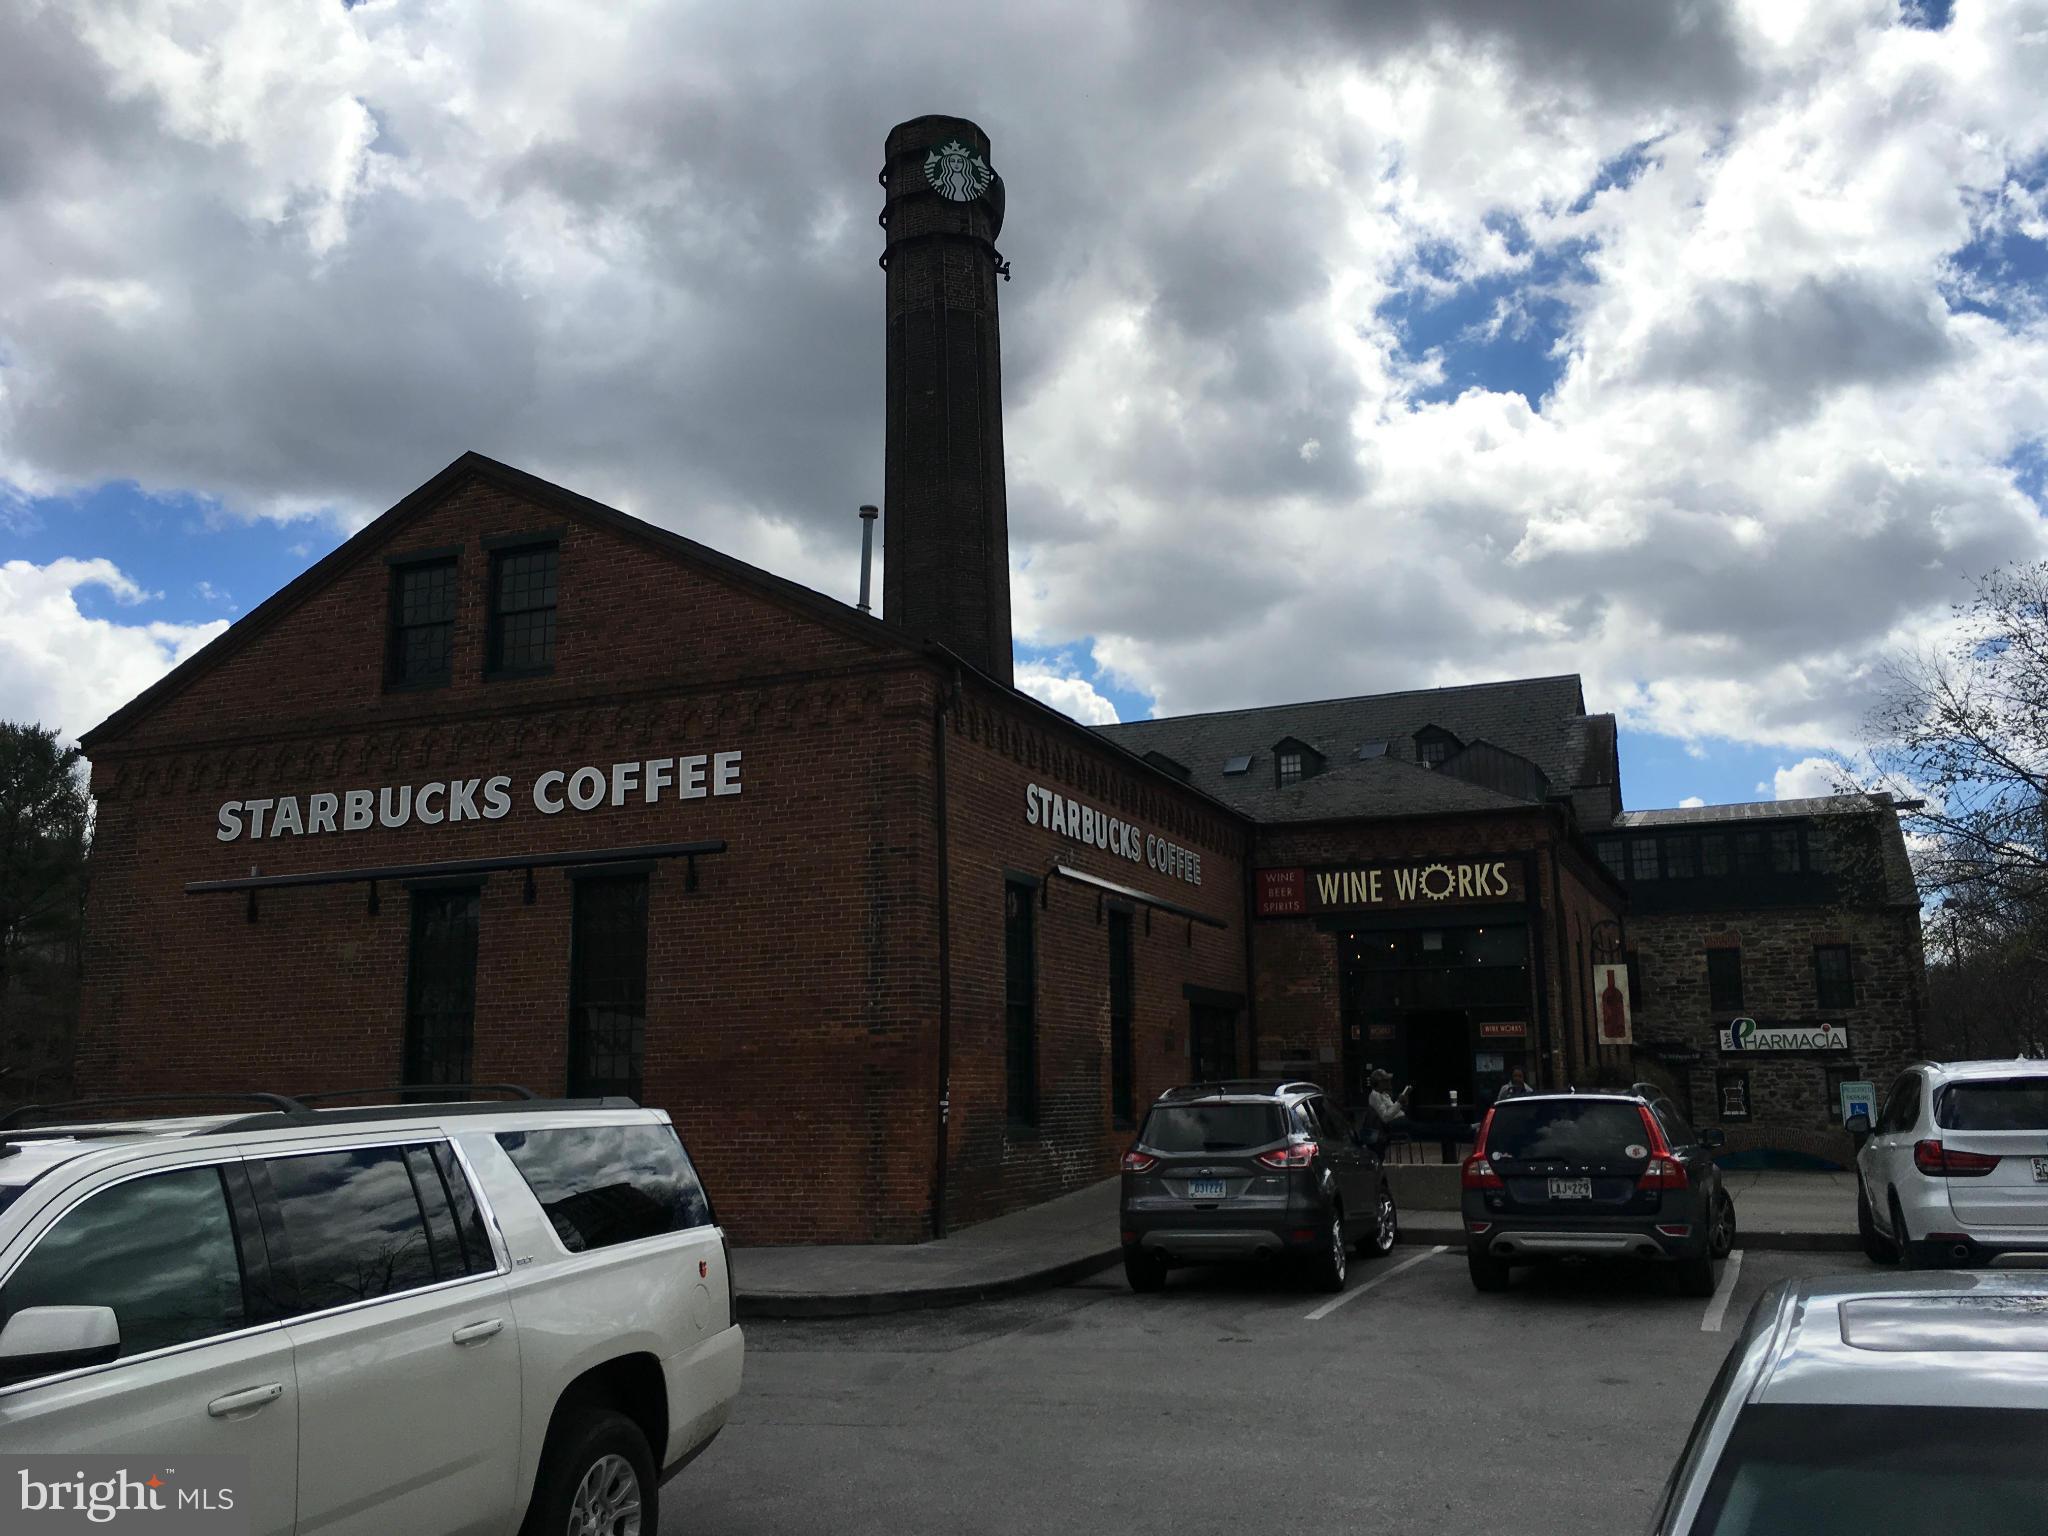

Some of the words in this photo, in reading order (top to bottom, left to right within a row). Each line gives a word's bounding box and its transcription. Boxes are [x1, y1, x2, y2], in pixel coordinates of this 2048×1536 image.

[216, 775, 512, 842] STARBUCKS
[532, 750, 742, 815] COFFEE
[1026, 783, 1142, 863] STARBUCKS
[1146, 833, 1202, 885] COFFEE
[1265, 871, 1296, 883] WINE
[1316, 870, 1384, 904] WINE
[1394, 863, 1509, 901] WORKS
[1268, 887, 1293, 897] BEER
[1264, 901, 1300, 912] SPIRITS
